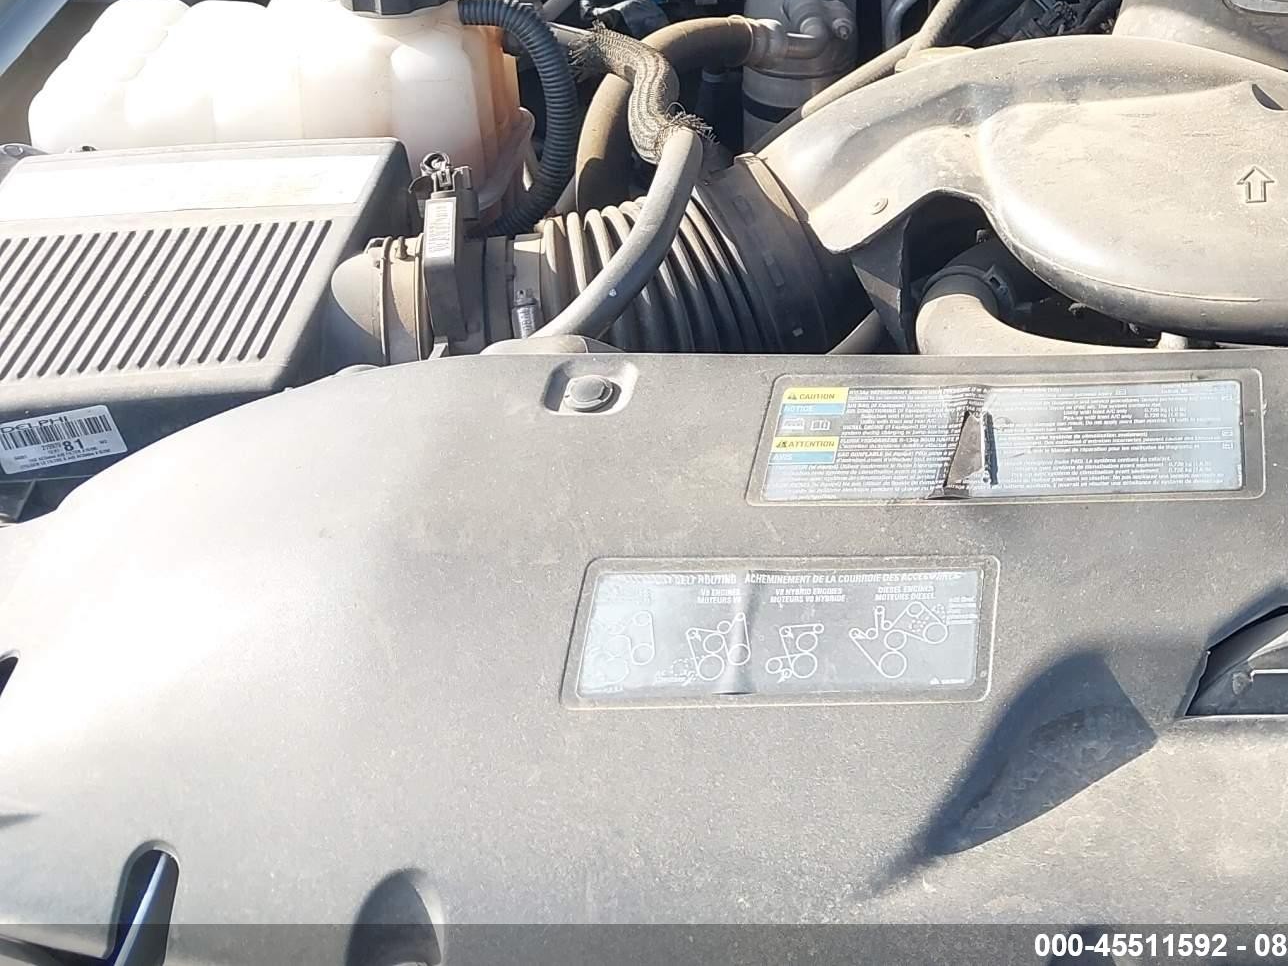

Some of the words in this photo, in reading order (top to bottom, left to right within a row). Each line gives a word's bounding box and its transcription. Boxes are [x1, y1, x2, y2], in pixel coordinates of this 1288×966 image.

[62, 438, 85, 452] 81
[789, 440, 834, 448] ATTENTION
[745, 573, 811, 584] ACHEMINEMENT
[812, 574, 823, 584] DE
[825, 574, 837, 584] LA
